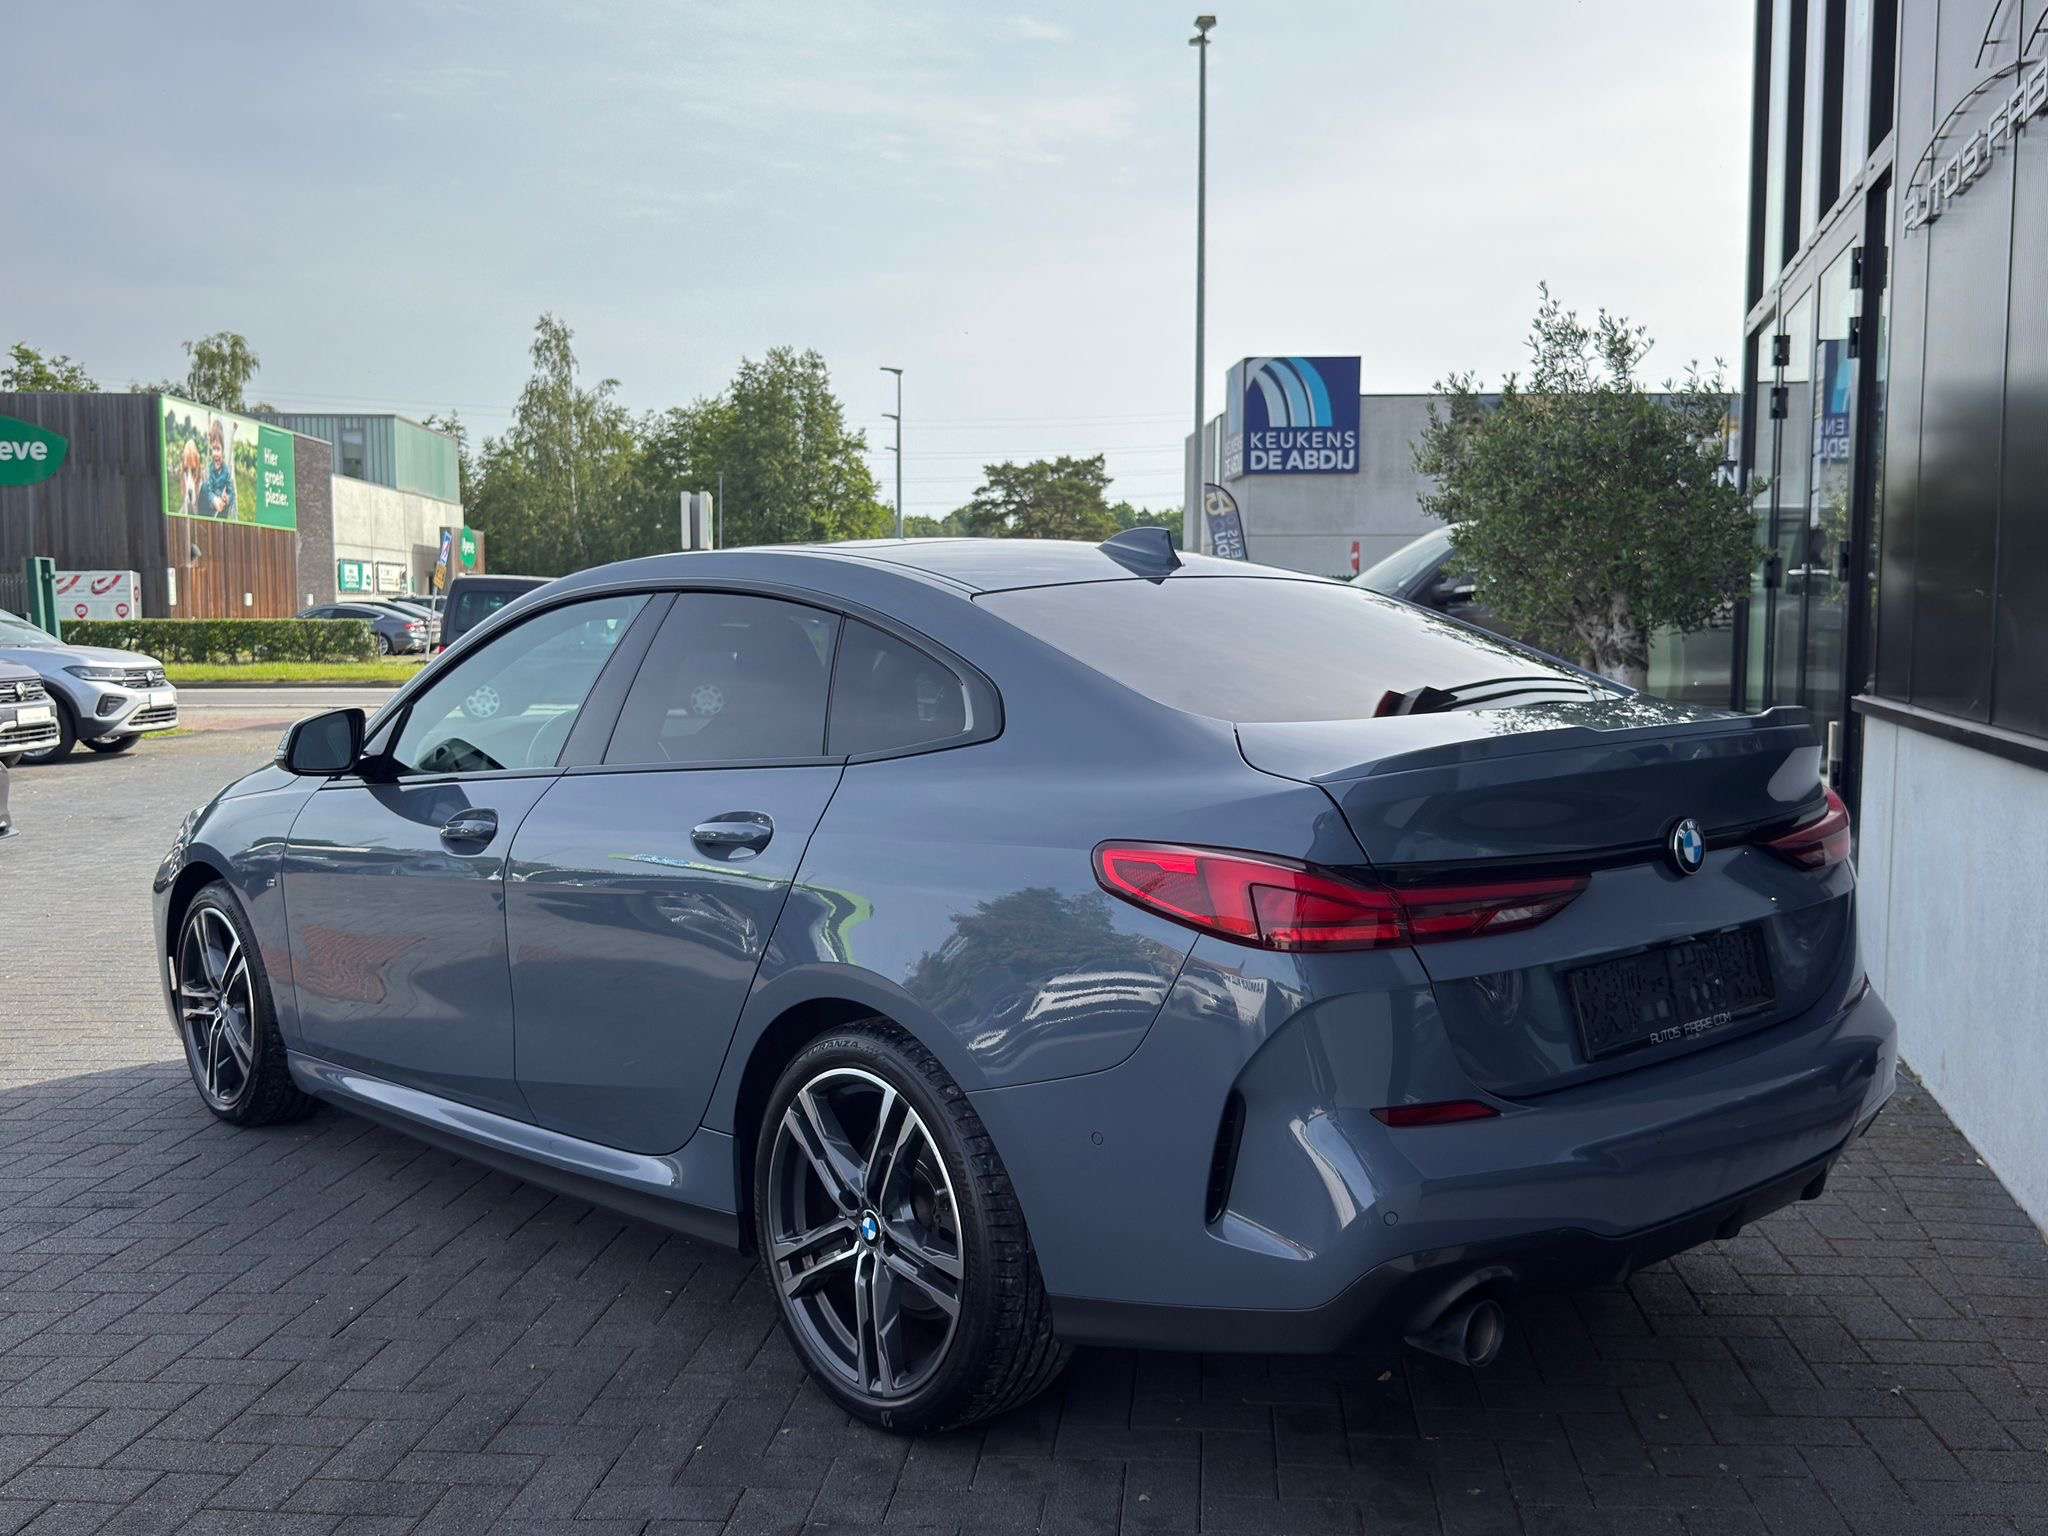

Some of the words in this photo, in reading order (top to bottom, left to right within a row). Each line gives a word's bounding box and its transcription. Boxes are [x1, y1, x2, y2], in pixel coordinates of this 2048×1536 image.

[1904, 129, 1981, 239] AUTOS
[1250, 431, 1356, 449] KEUKENS
[1250, 450, 1282, 470] DE
[1285, 449, 1355, 470] ABDIJ
